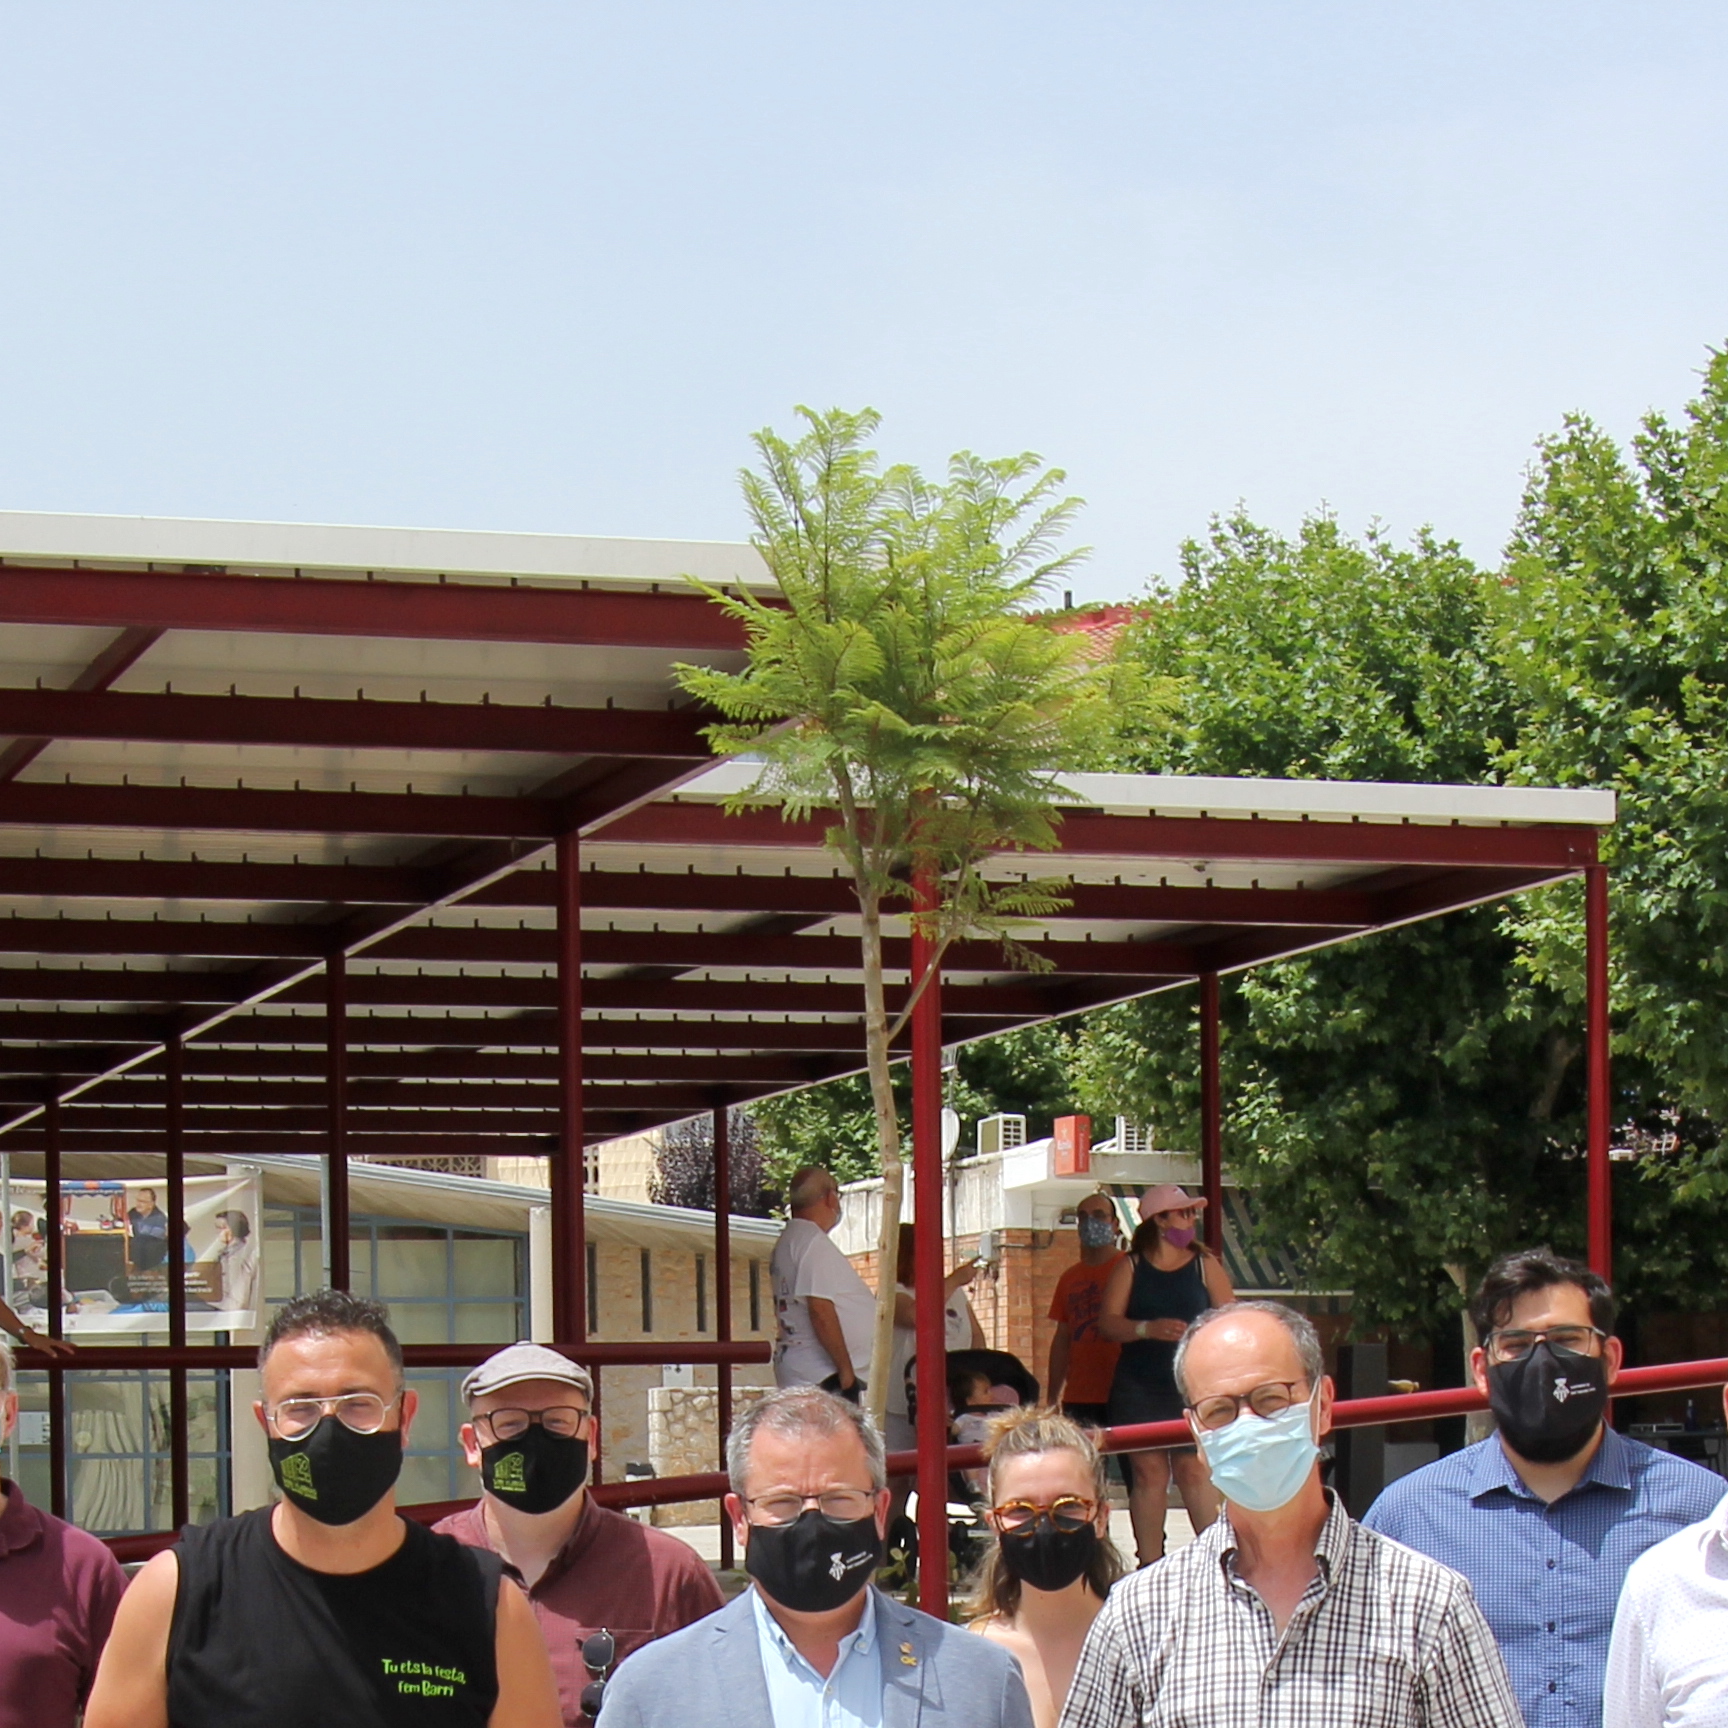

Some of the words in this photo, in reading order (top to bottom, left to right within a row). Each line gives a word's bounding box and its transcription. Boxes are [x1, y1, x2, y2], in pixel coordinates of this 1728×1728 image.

[381, 1658, 398, 1674] Tu
[400, 1660, 420, 1674] ets
[421, 1662, 432, 1675] la
[422, 1680, 454, 1697] Barri
